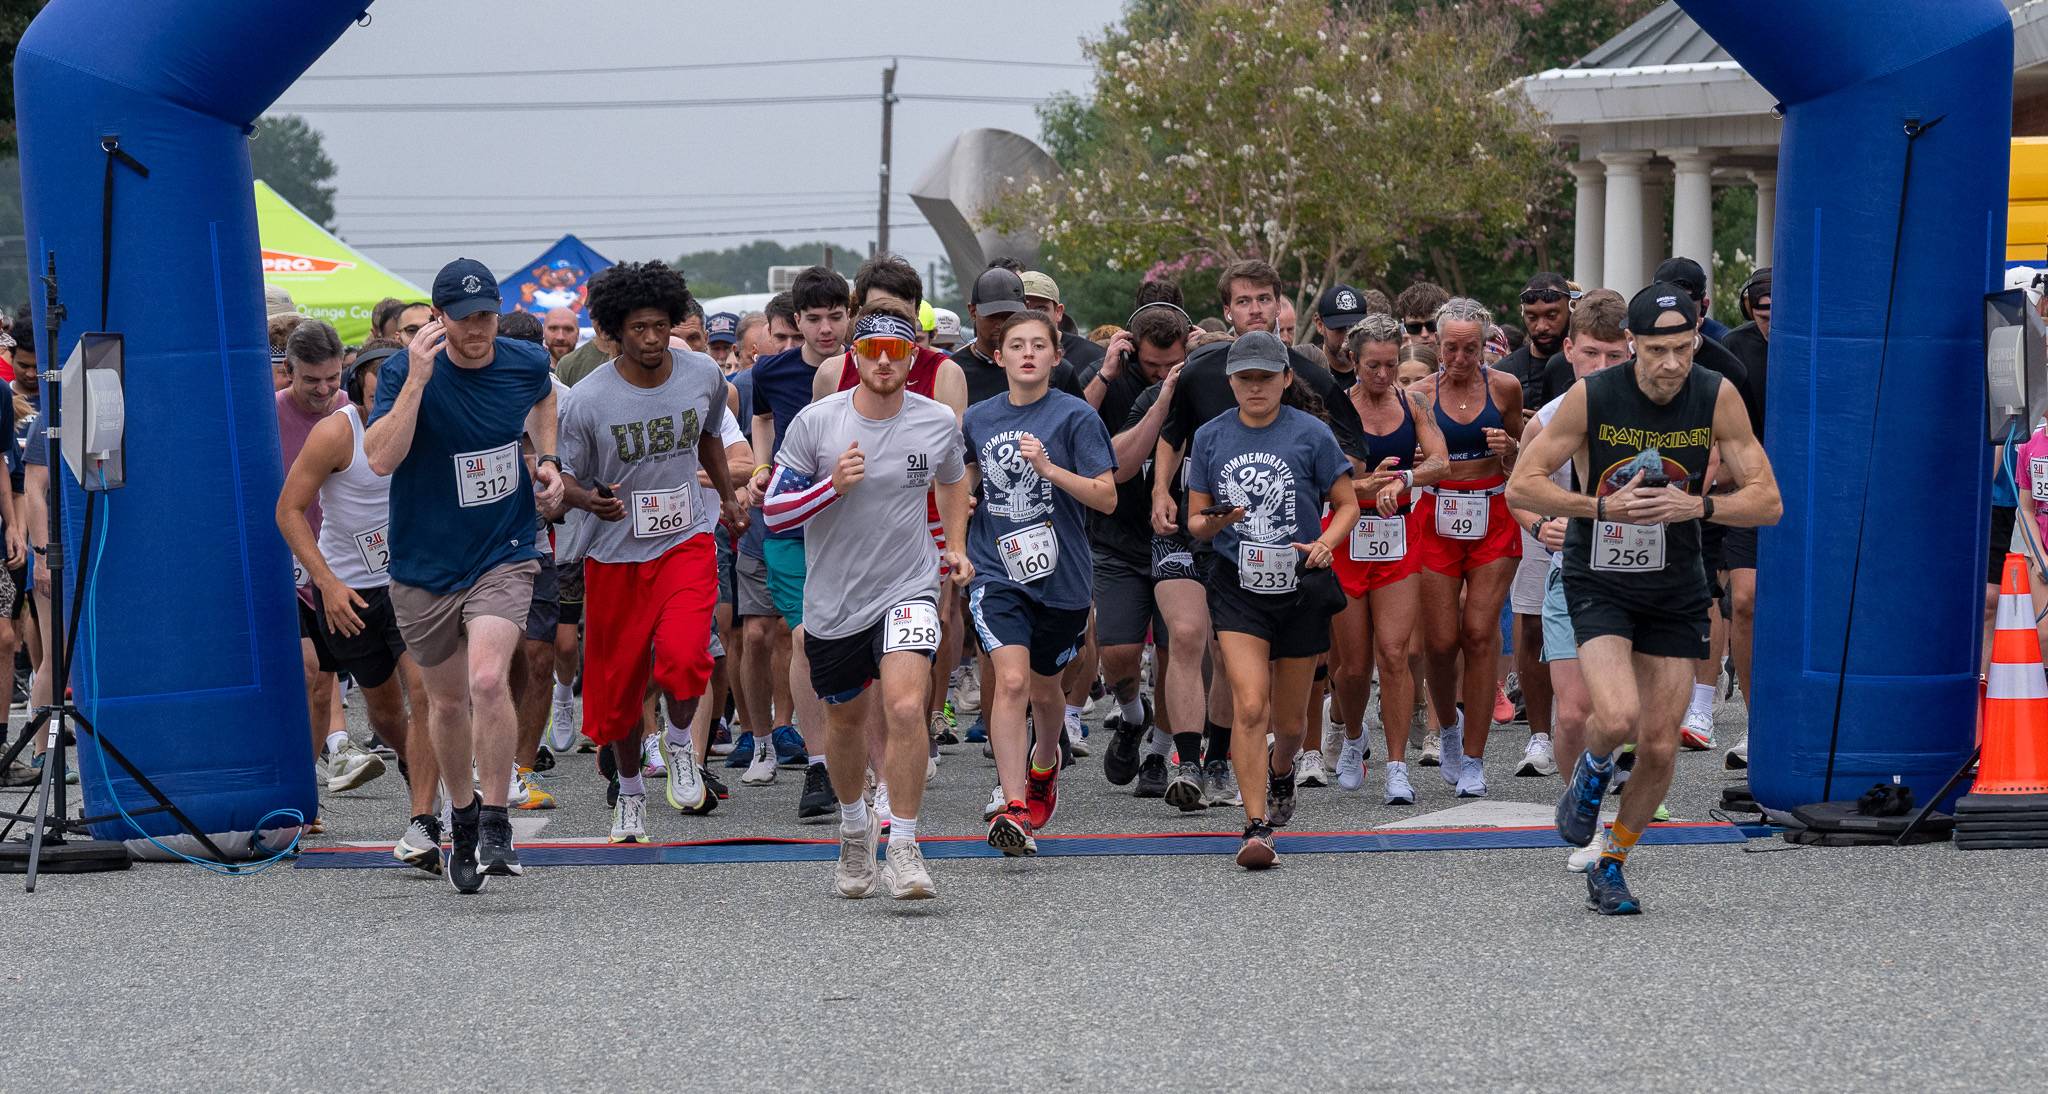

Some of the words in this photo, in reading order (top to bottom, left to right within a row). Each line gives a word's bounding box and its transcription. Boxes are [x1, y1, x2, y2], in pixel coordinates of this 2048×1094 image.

[296, 304, 346, 320] Orange
[609, 408, 699, 464] USA
[1599, 424, 1644, 451] IRON
[1645, 427, 1710, 449] MAIDEN
[907, 454, 928, 471] 9.11
[476, 476, 507, 499] 312
[1221, 452, 1295, 487] COMMEMORATIVE
[1284, 489, 1296, 521] EVENT
[648, 512, 682, 531] 266
[1451, 519, 1472, 534] 49
[1369, 541, 1389, 556] 50
[1608, 548, 1649, 566] 256
[1017, 553, 1049, 576] 160
[1253, 572, 1287, 588] 233
[899, 627, 936, 644] 258
